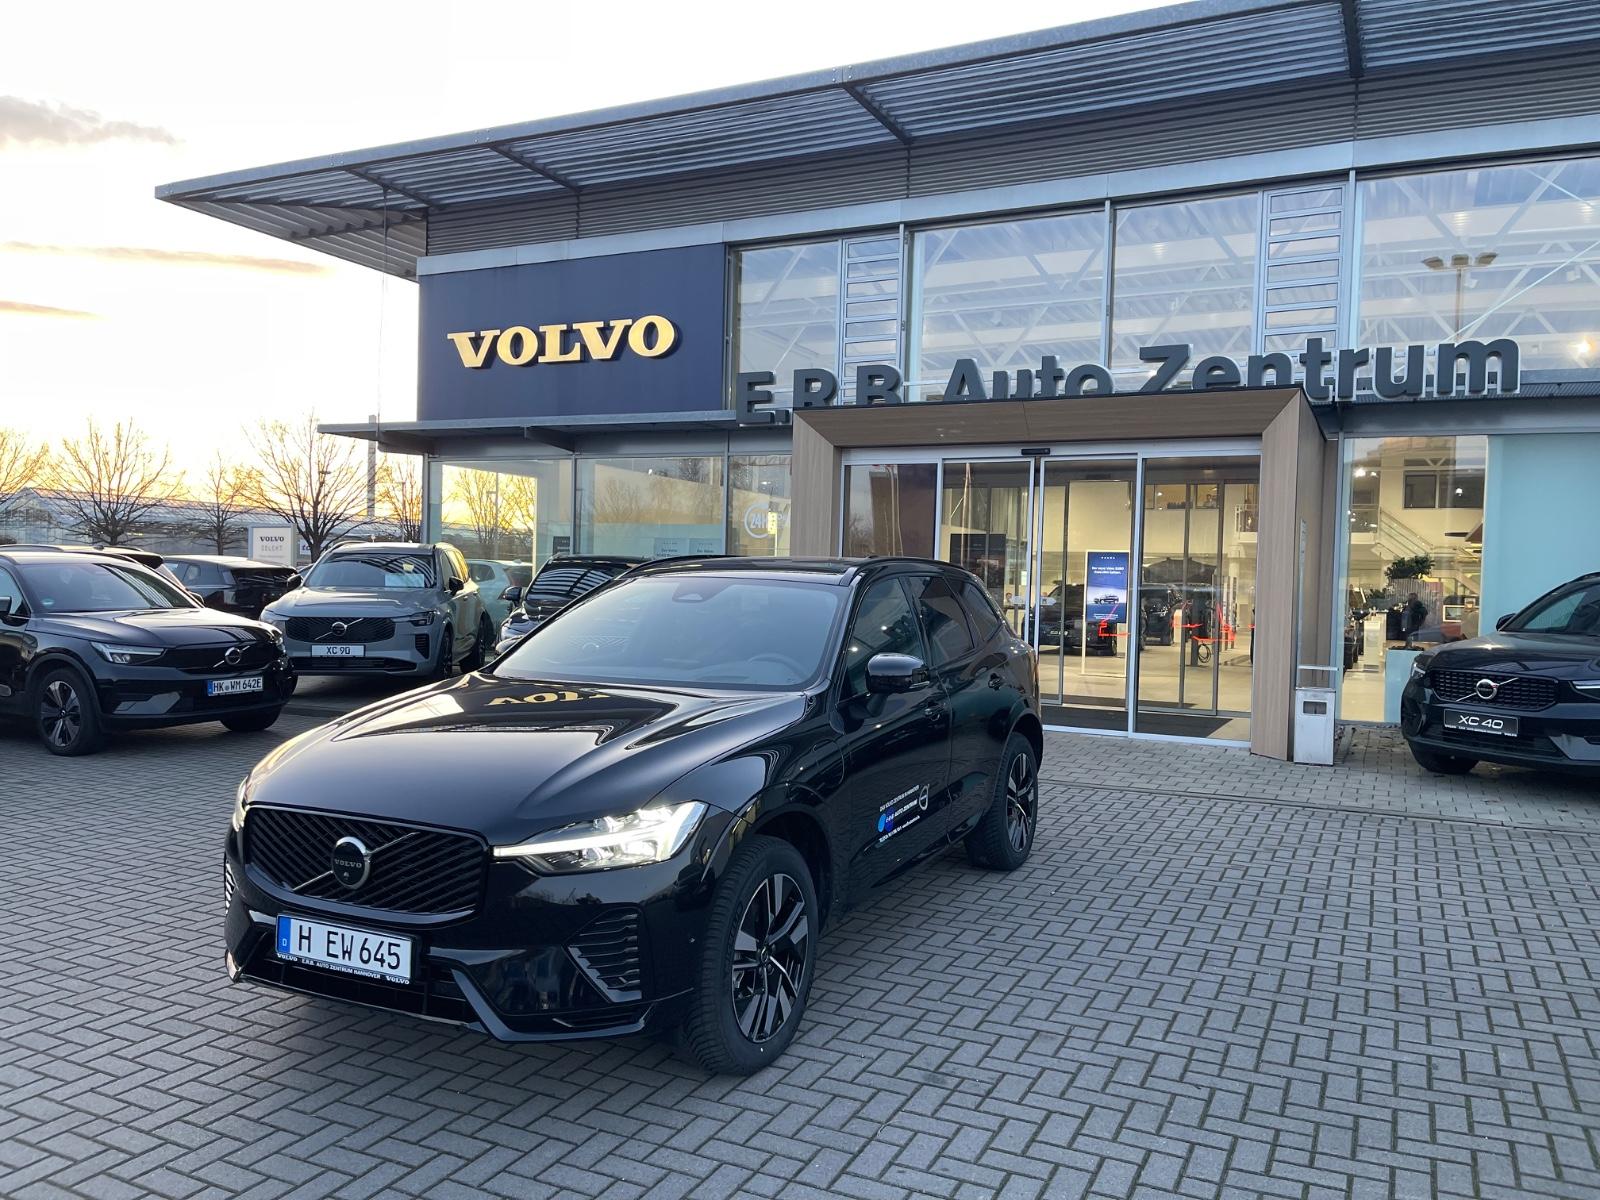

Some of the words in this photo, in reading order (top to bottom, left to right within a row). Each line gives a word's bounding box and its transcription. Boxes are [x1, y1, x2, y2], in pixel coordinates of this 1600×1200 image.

[447, 314, 678, 369] VOLVO
[943, 355, 1113, 400] Auto
[1139, 337, 1520, 401] Zentrum
[326, 646, 337, 655] XC
[340, 646, 351, 655] 90
[213, 682, 225, 692] HK
[230, 681, 240, 691] WM
[242, 679, 262, 690] 642E
[1458, 715, 1480, 726] XC
[1481, 718, 1504, 729] 40
[334, 858, 362, 869] VOLVO
[298, 924, 312, 953] H
[277, 952, 298, 962] VOLVO
[329, 964, 353, 974] ZENTRUM
[353, 969, 381, 980] HANNOVER
[385, 975, 410, 985] VOLVO
